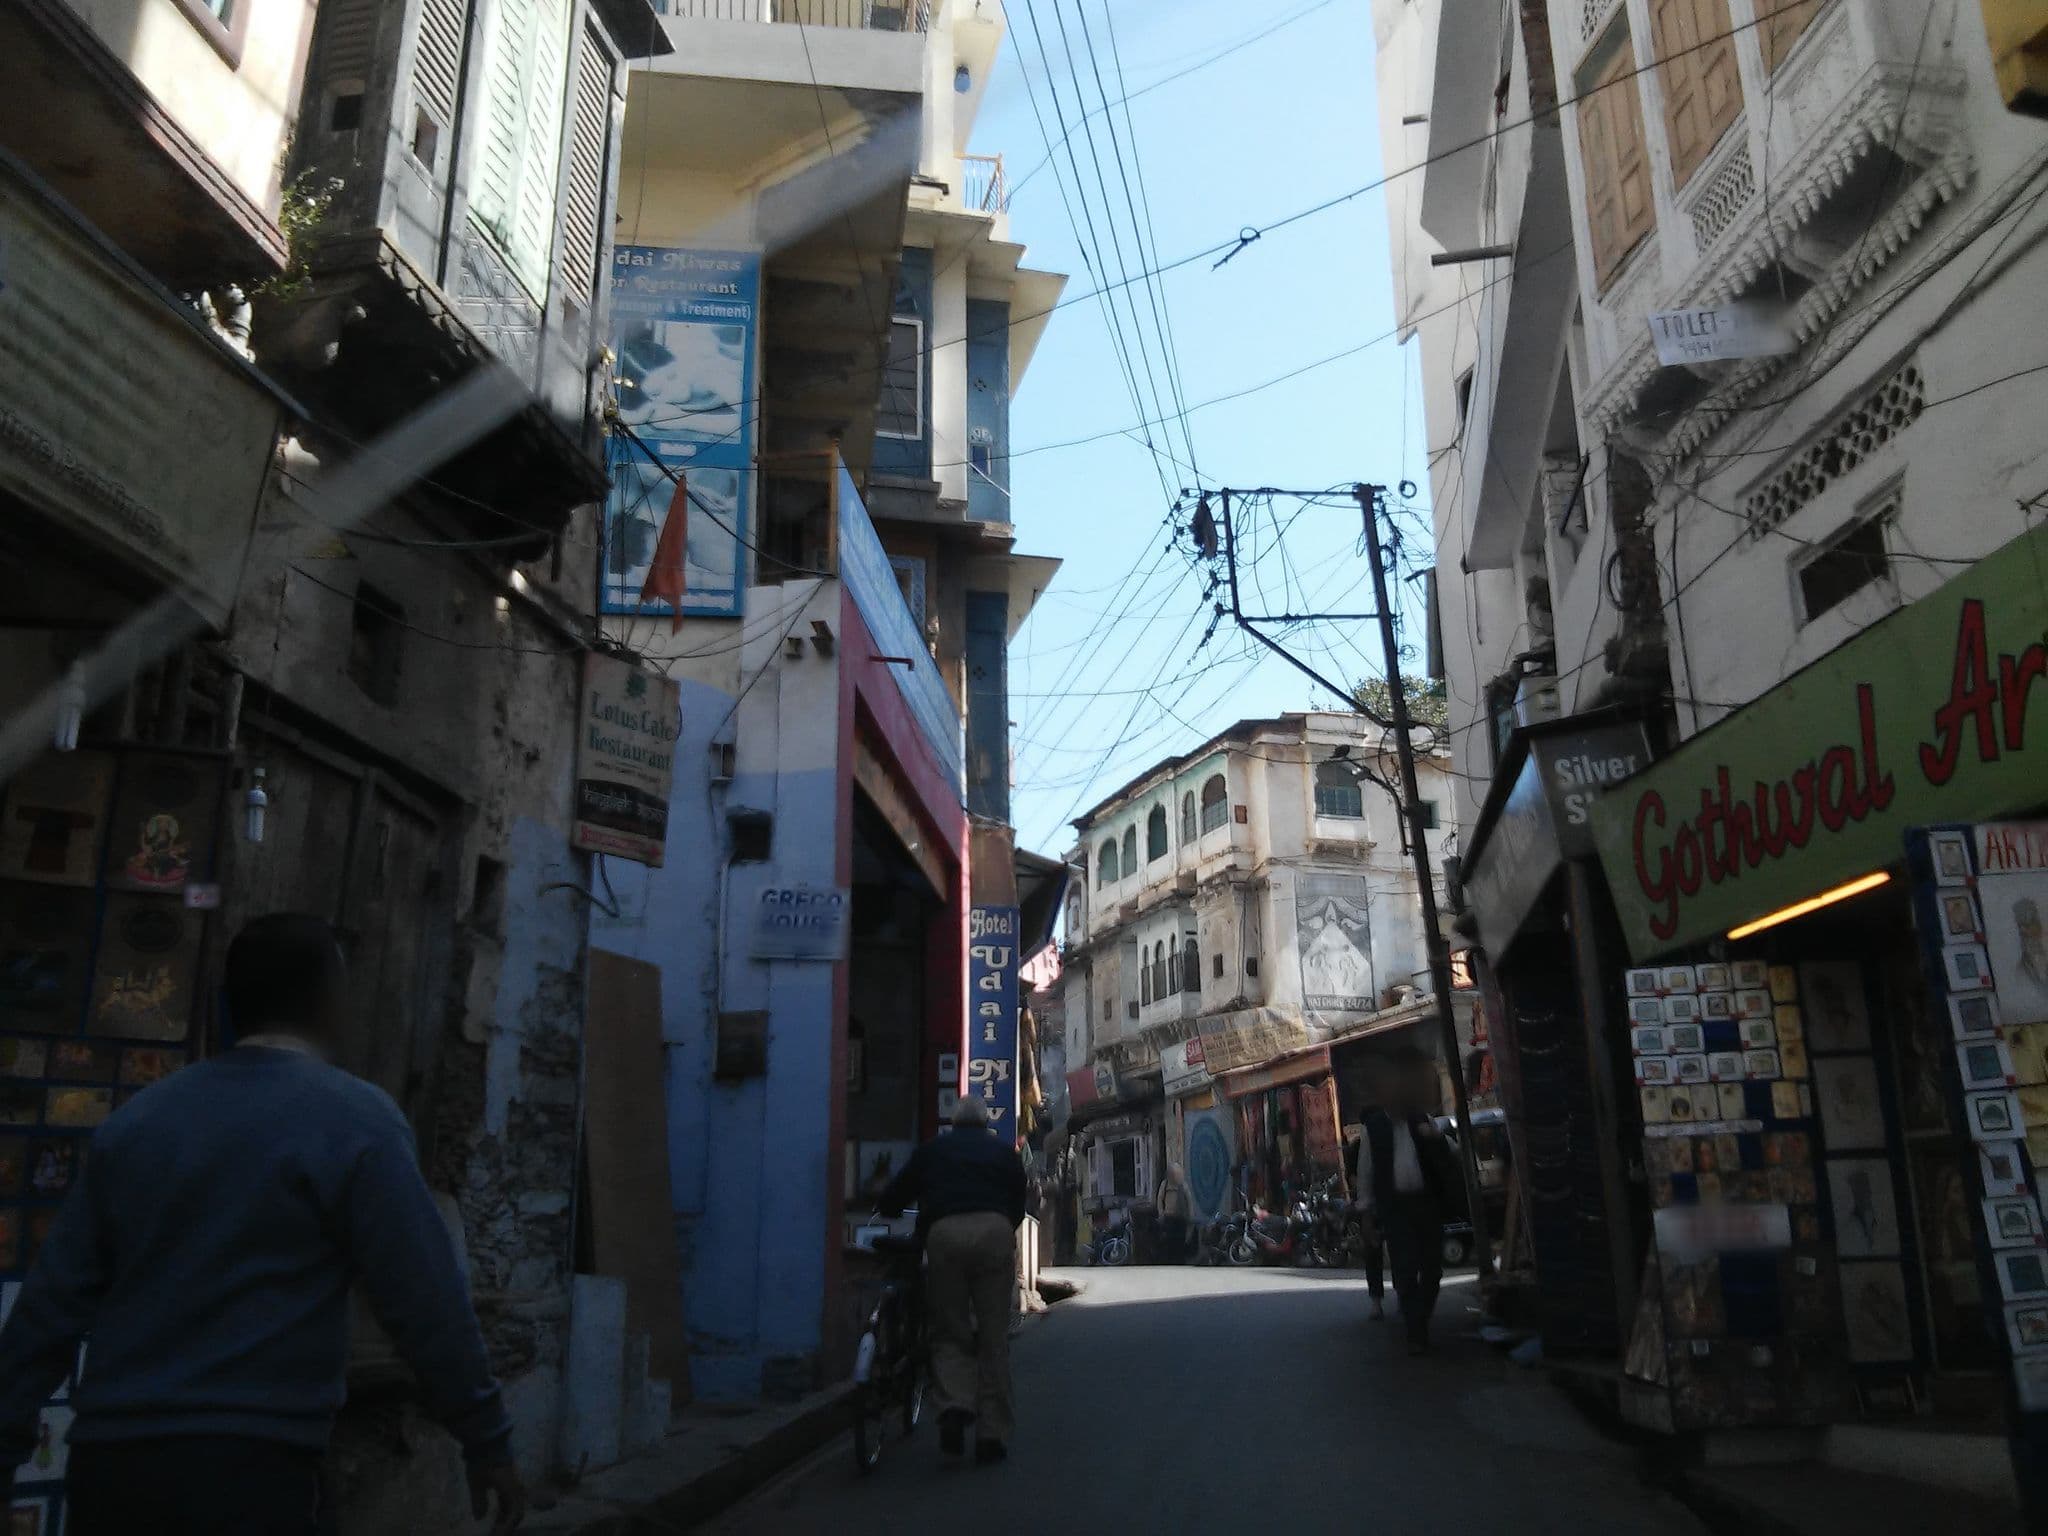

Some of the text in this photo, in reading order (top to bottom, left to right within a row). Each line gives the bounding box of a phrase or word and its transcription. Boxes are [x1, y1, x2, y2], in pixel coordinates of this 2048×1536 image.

[615, 250, 654, 266] dai
[1554, 755, 1637, 788] Silver
[1632, 599, 2048, 941] Gothwal Ar
[1564, 789, 1598, 825] S
[969, 907, 1013, 940] Hotel
[969, 945, 1012, 1042] Udai
